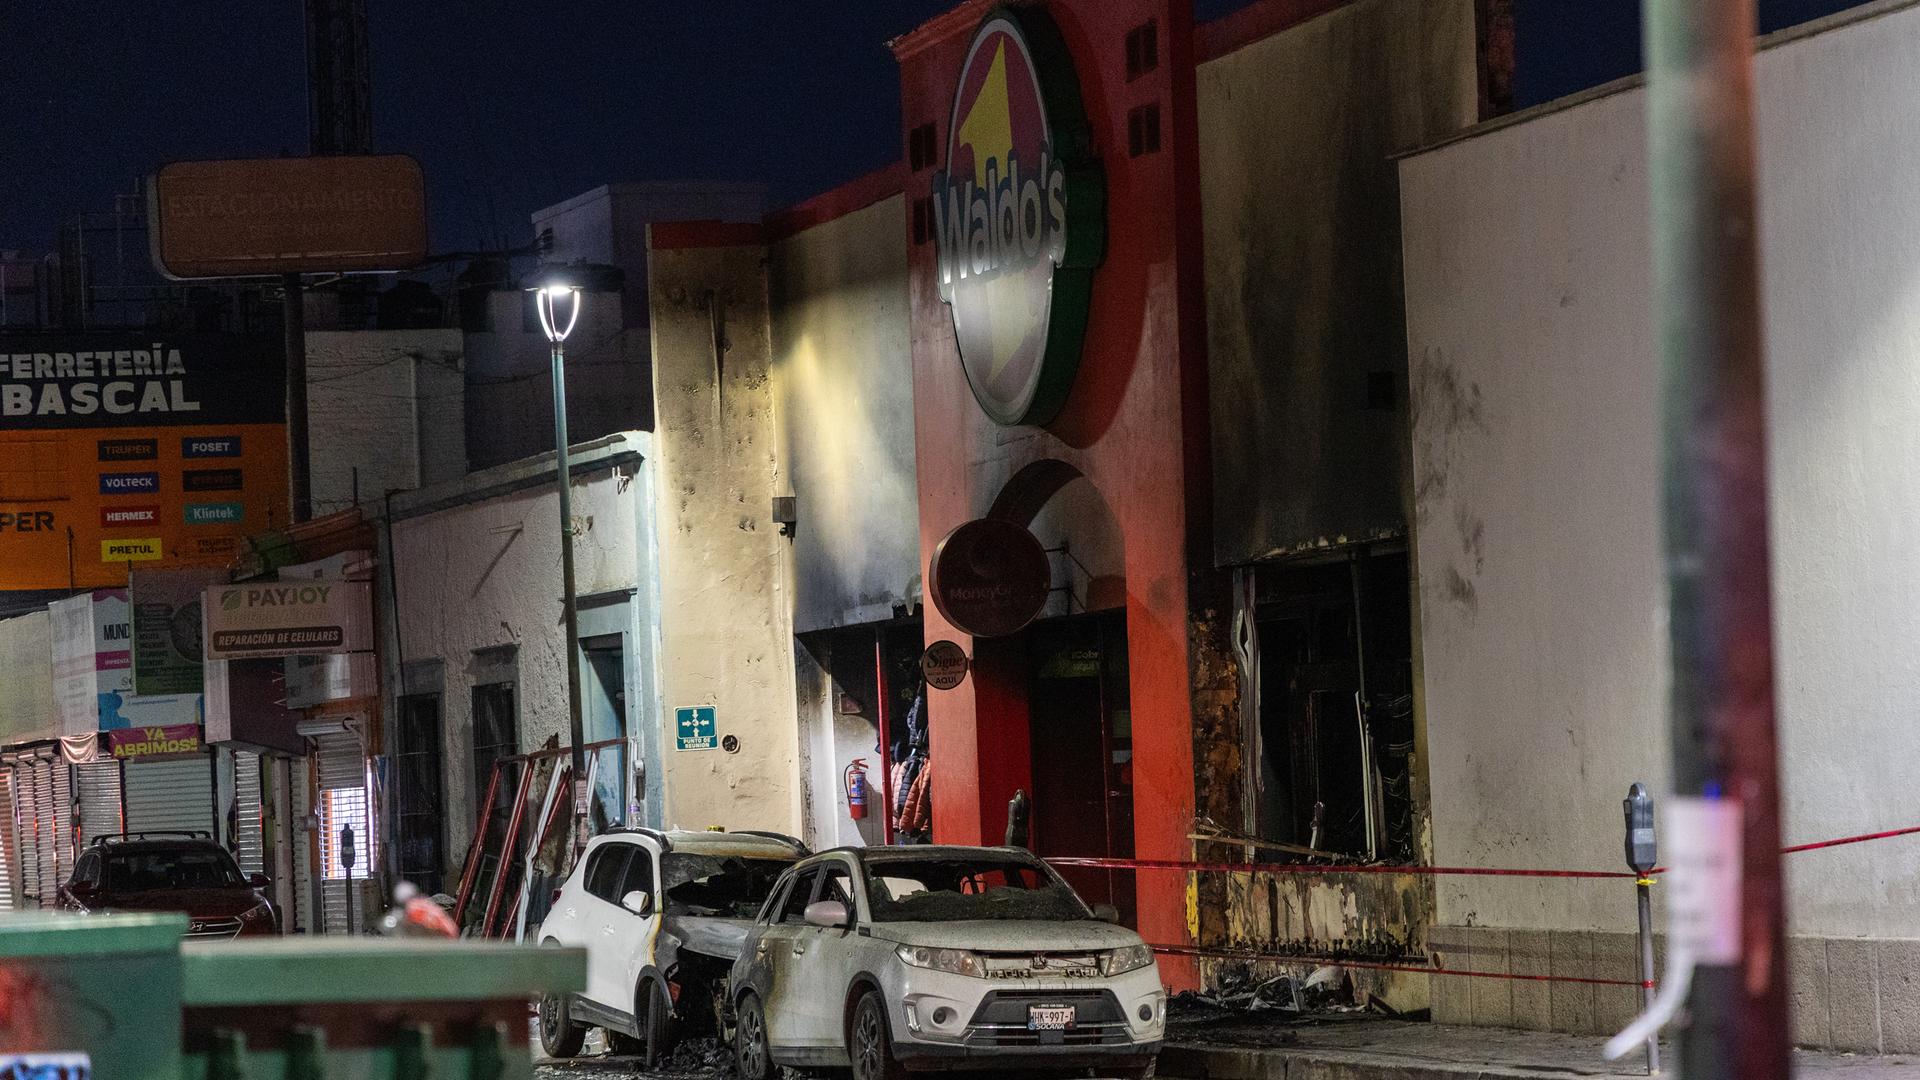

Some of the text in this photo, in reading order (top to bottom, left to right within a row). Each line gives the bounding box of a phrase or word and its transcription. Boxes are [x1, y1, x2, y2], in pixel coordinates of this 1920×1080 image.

[168, 188, 416, 217] ESTACIONAMIENTO
[934, 152, 1066, 284] Waldo's
[1, 380, 201, 416] BASCAL
[103, 444, 152, 455] TRUPER
[192, 442, 230, 453] FOSET
[106, 511, 154, 522] HERMEX
[193, 506, 235, 520] Klintek
[109, 545, 154, 555] PRETUL
[247, 586, 331, 607] PAYJOY
[219, 630, 340, 646] REPARACIÓN DE CELULARES
[144, 728, 166, 741] YA
